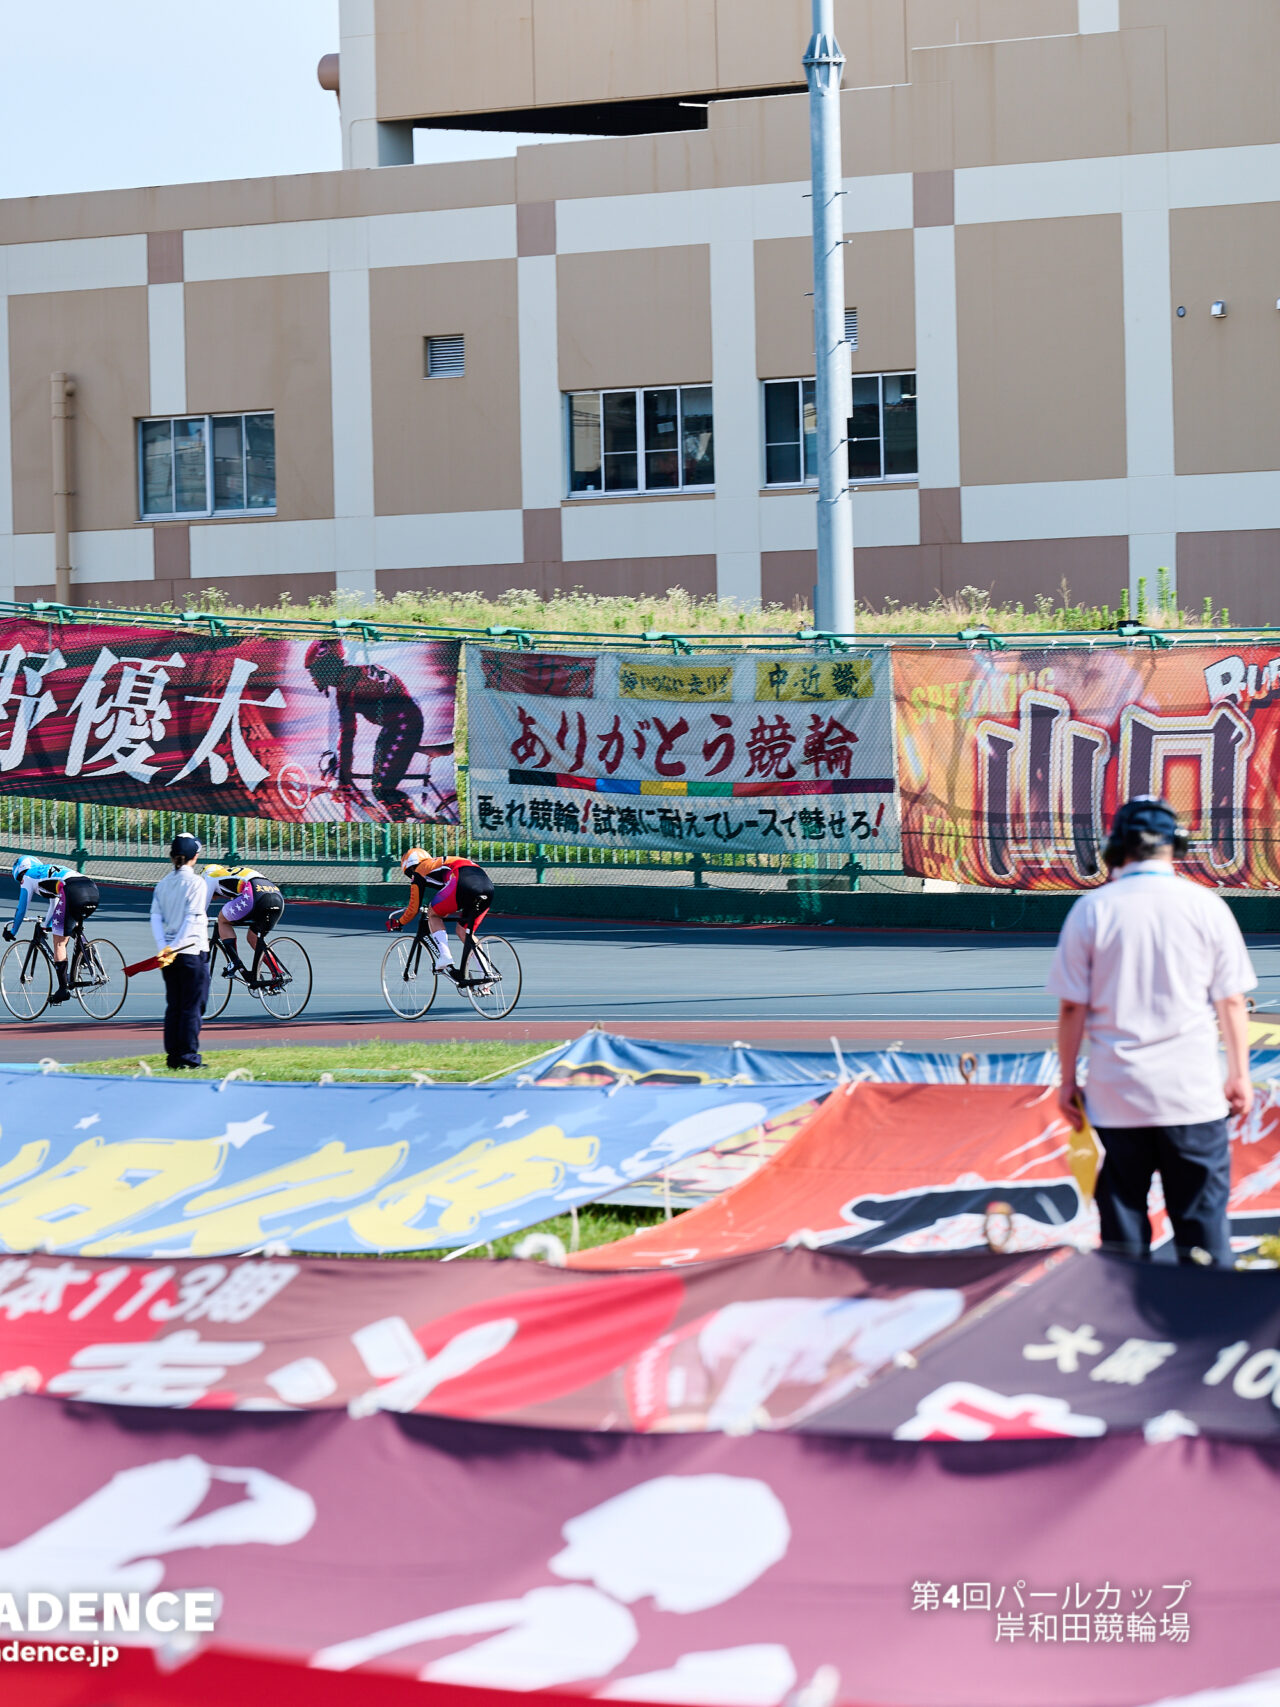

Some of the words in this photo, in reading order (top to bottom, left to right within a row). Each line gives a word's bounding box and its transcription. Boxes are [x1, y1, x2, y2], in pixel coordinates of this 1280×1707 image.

[510, 706, 860, 779] ありがとう競輪
